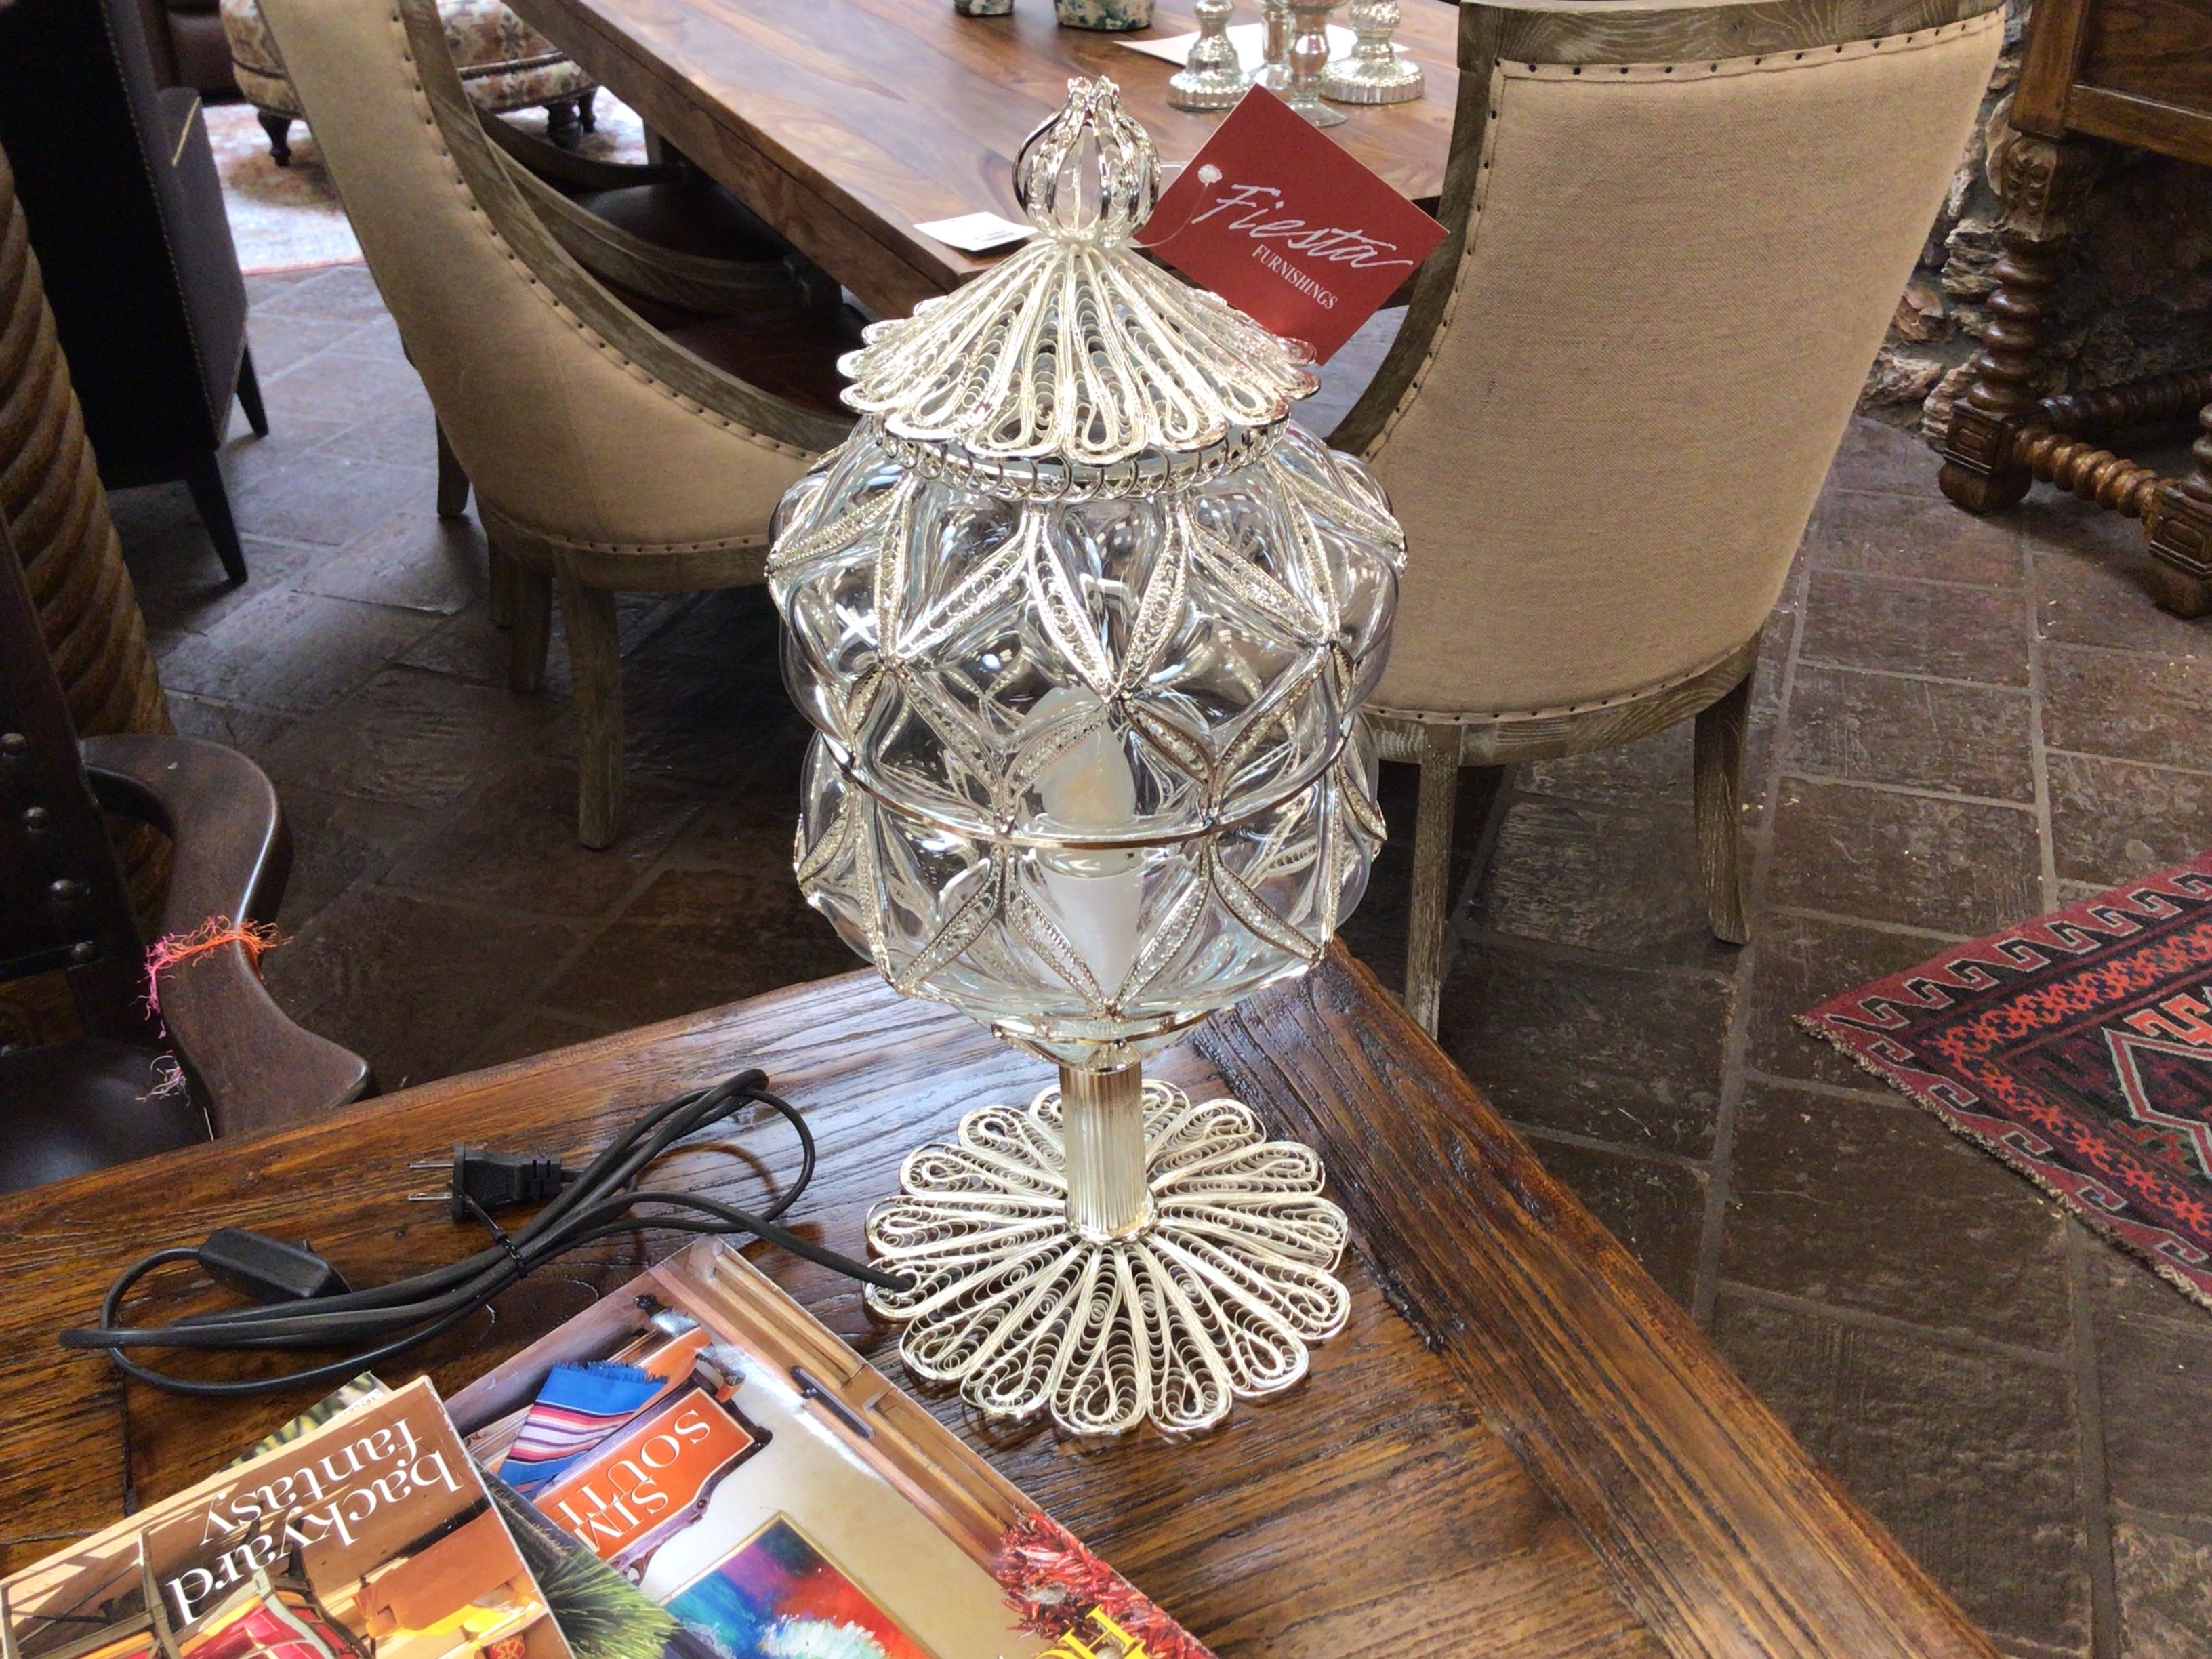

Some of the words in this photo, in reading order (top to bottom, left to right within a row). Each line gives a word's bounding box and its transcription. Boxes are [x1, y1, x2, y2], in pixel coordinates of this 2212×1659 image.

[1191, 184, 1414, 268] Fiesta
[1252, 244, 1339, 310] FURNISHINGS
[200, 1417, 423, 1547] fantasy
[165, 1450, 464, 1626] backyard
